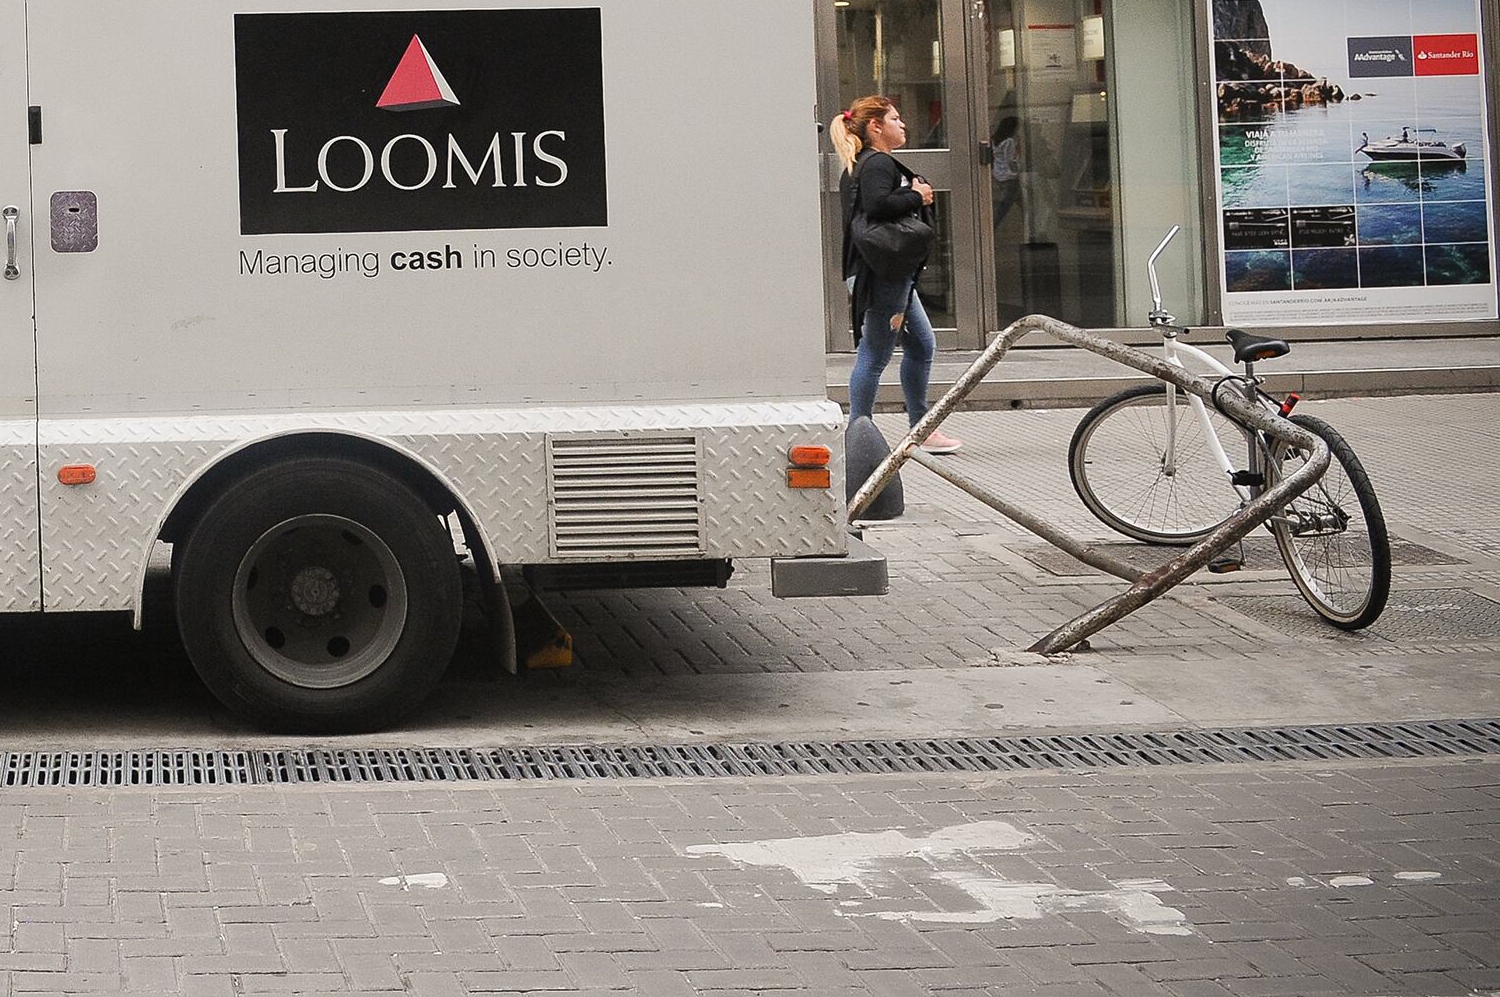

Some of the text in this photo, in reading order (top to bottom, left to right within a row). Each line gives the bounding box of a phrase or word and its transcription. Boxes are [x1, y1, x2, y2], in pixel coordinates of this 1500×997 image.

[1354, 53, 1396, 62] AAdvantage
[1428, 51, 1461, 60] Santander
[270, 128, 569, 194] LOOMIS
[239, 241, 613, 279] Managing cash in society.
